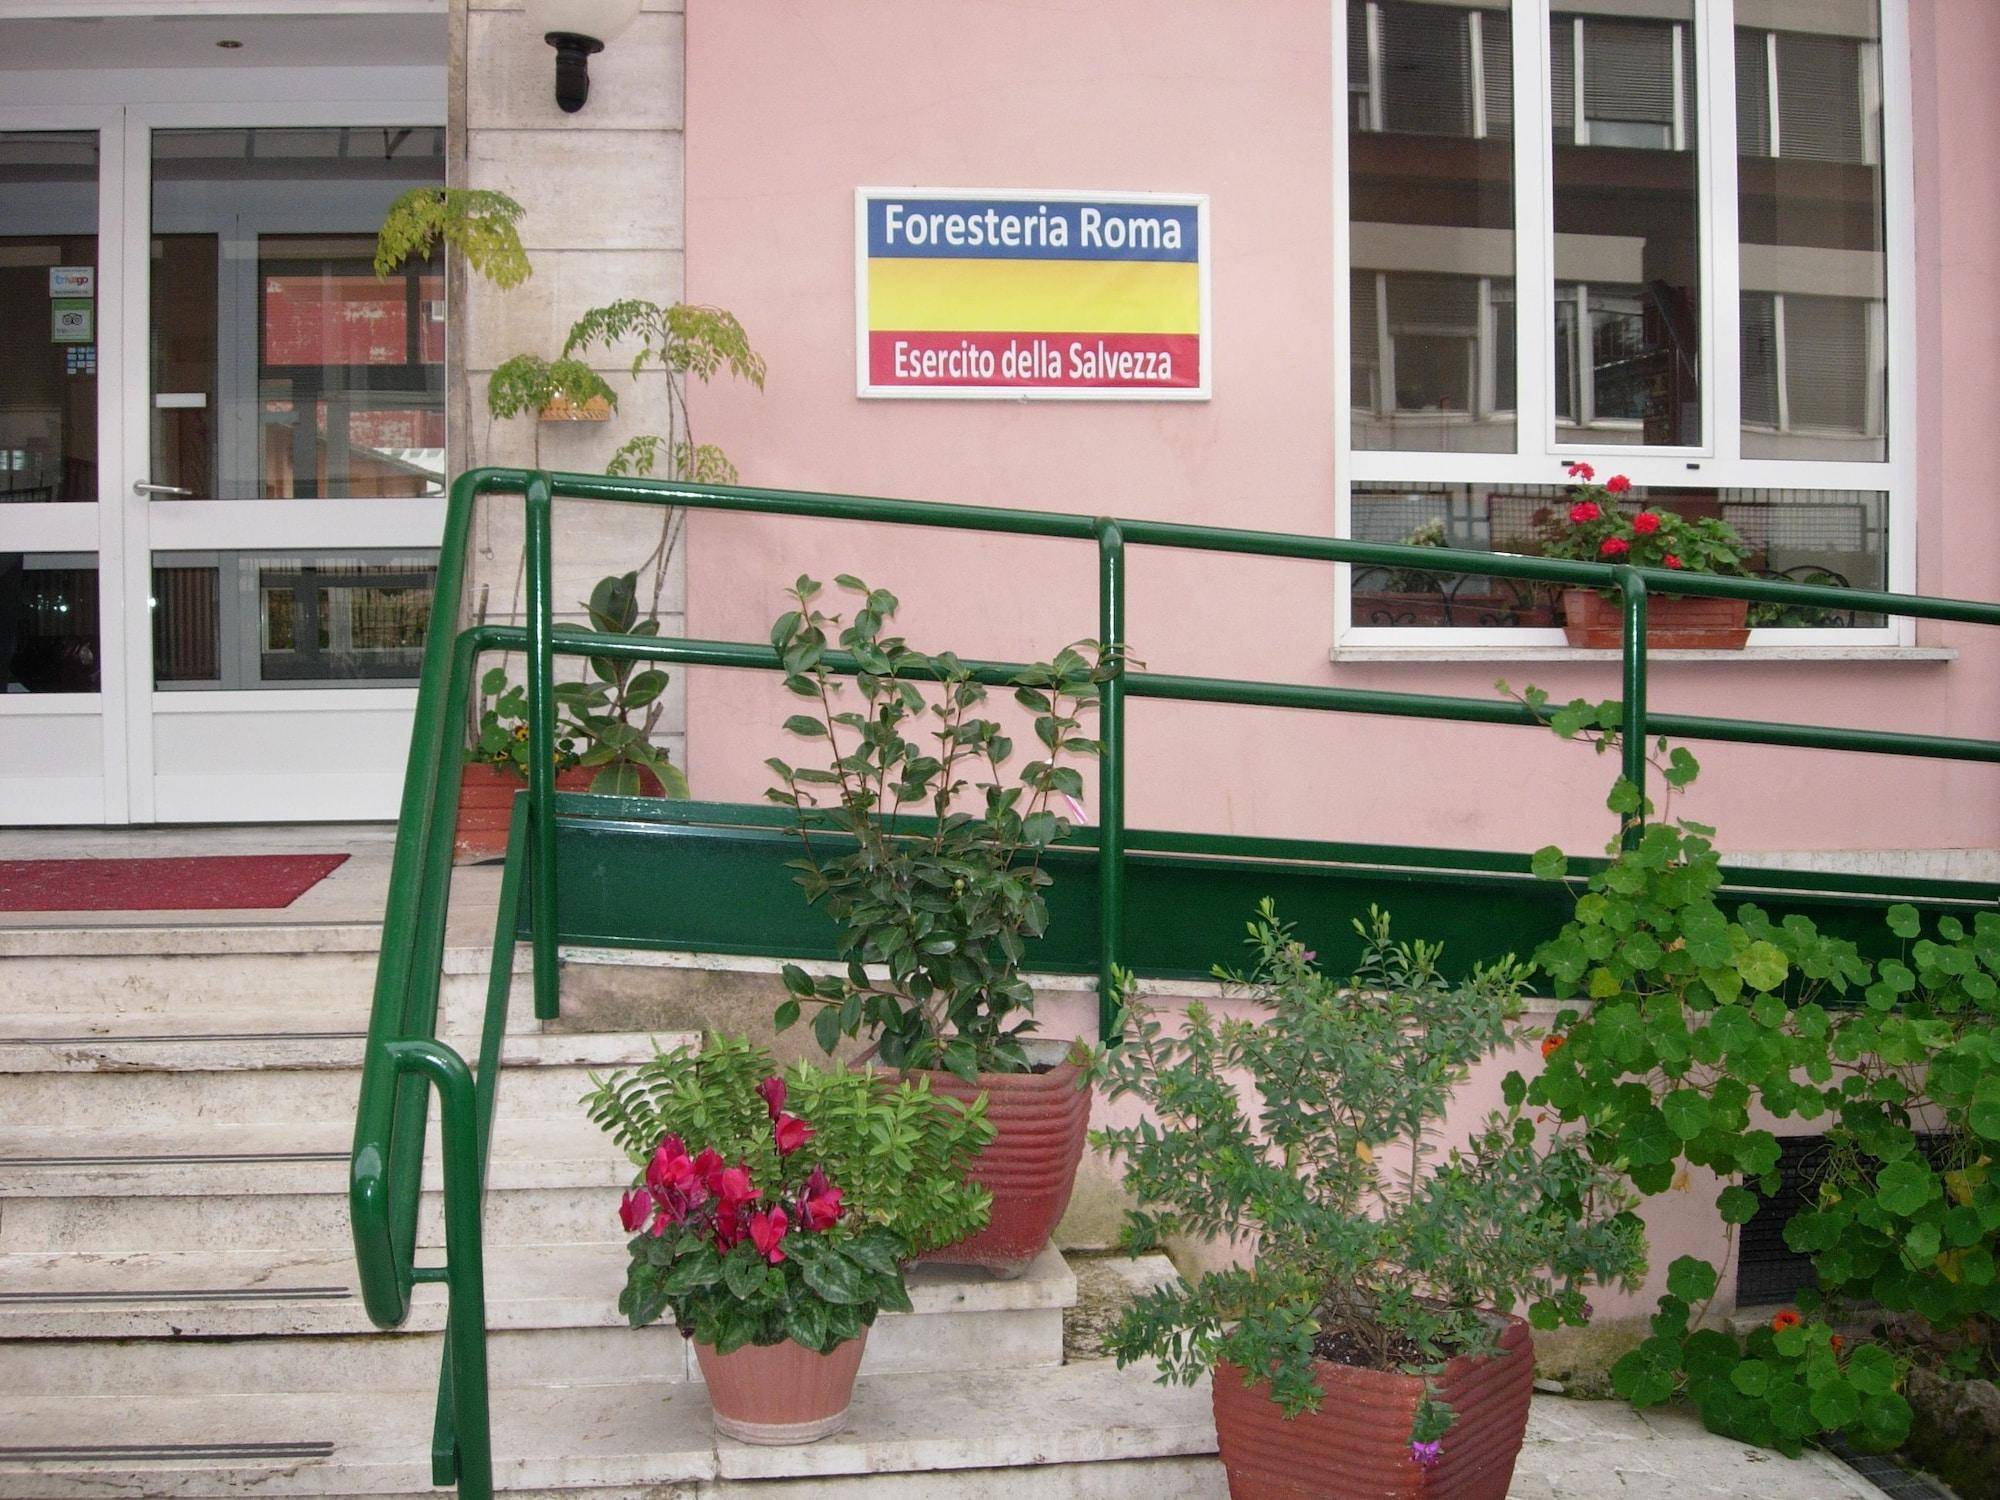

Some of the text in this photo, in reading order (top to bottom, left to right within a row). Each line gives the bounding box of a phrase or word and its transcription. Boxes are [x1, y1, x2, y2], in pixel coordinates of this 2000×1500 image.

[885, 204, 1182, 250] Foresteria Roma
[894, 339, 1172, 380] Esercito della Salvezza
